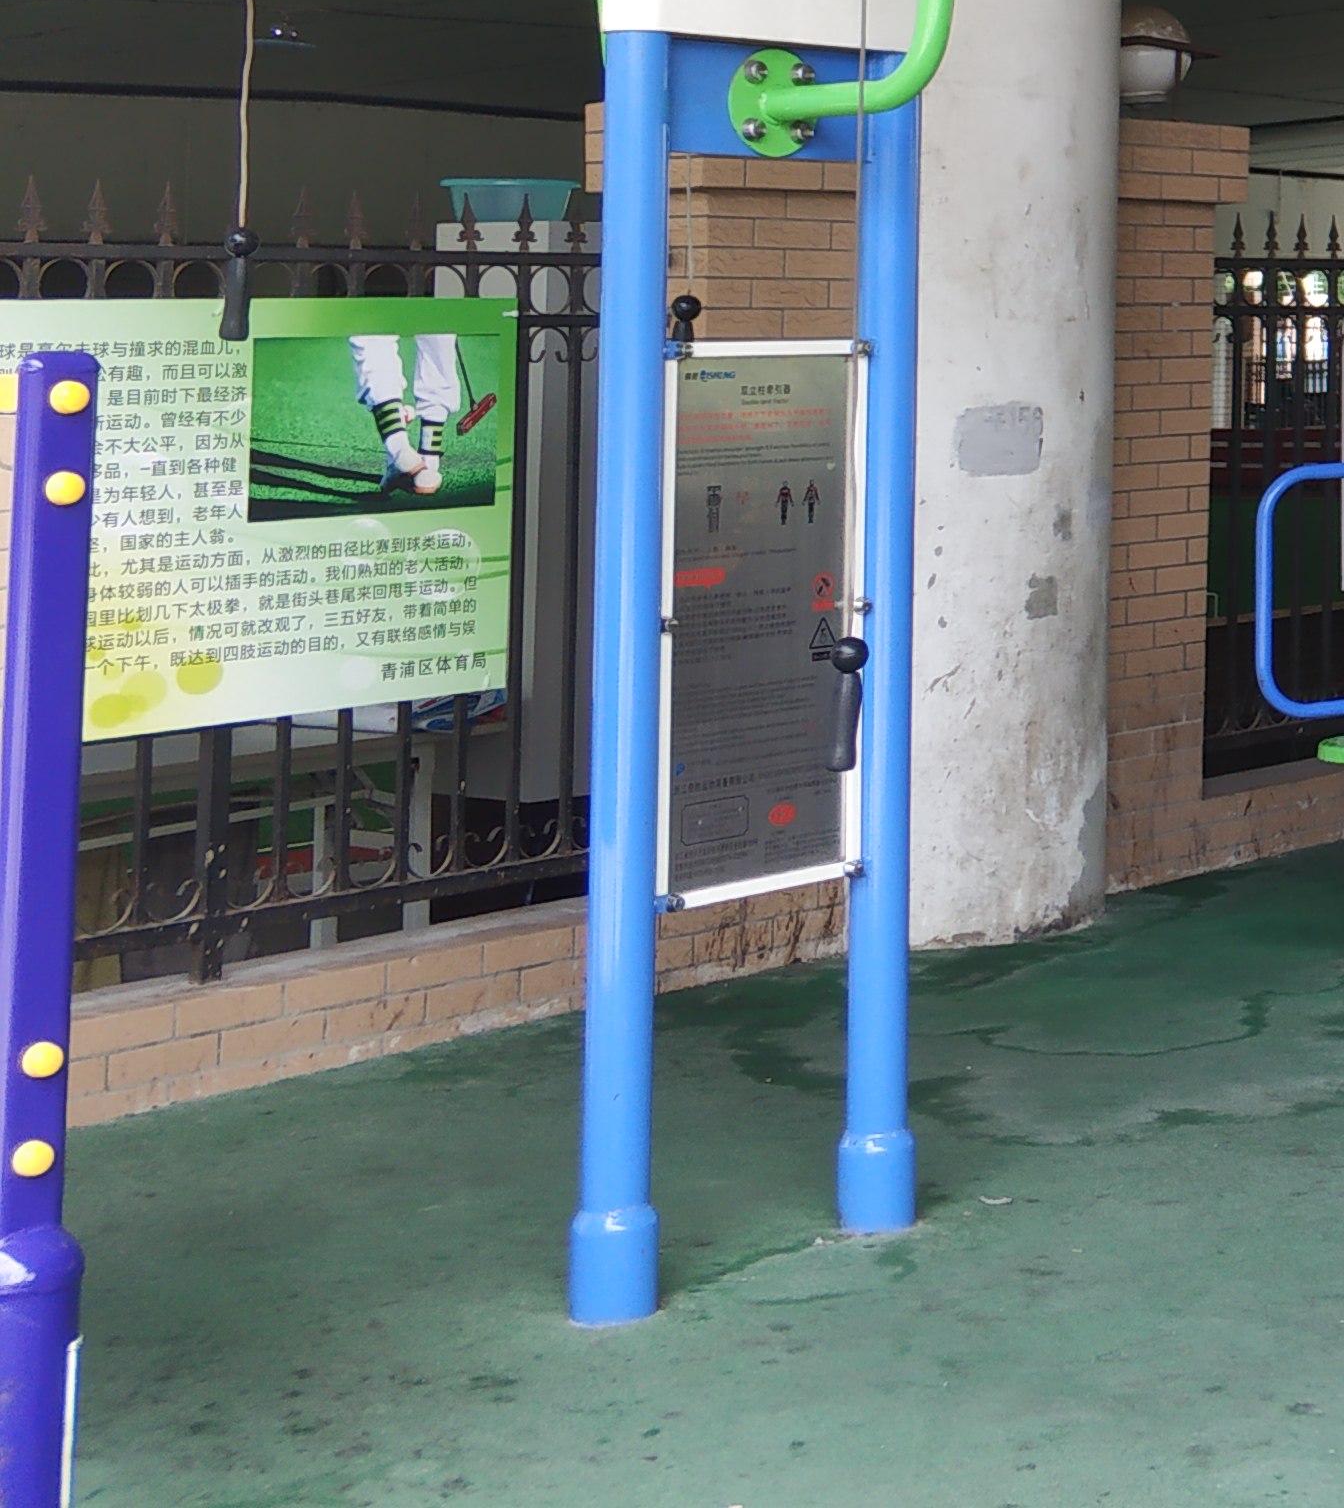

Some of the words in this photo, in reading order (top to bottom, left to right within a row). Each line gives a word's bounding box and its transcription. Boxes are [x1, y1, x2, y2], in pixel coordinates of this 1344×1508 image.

[106, 386, 248, 407] 是目前时下最经济
[380, 652, 487, 681] 青浦区体育局
